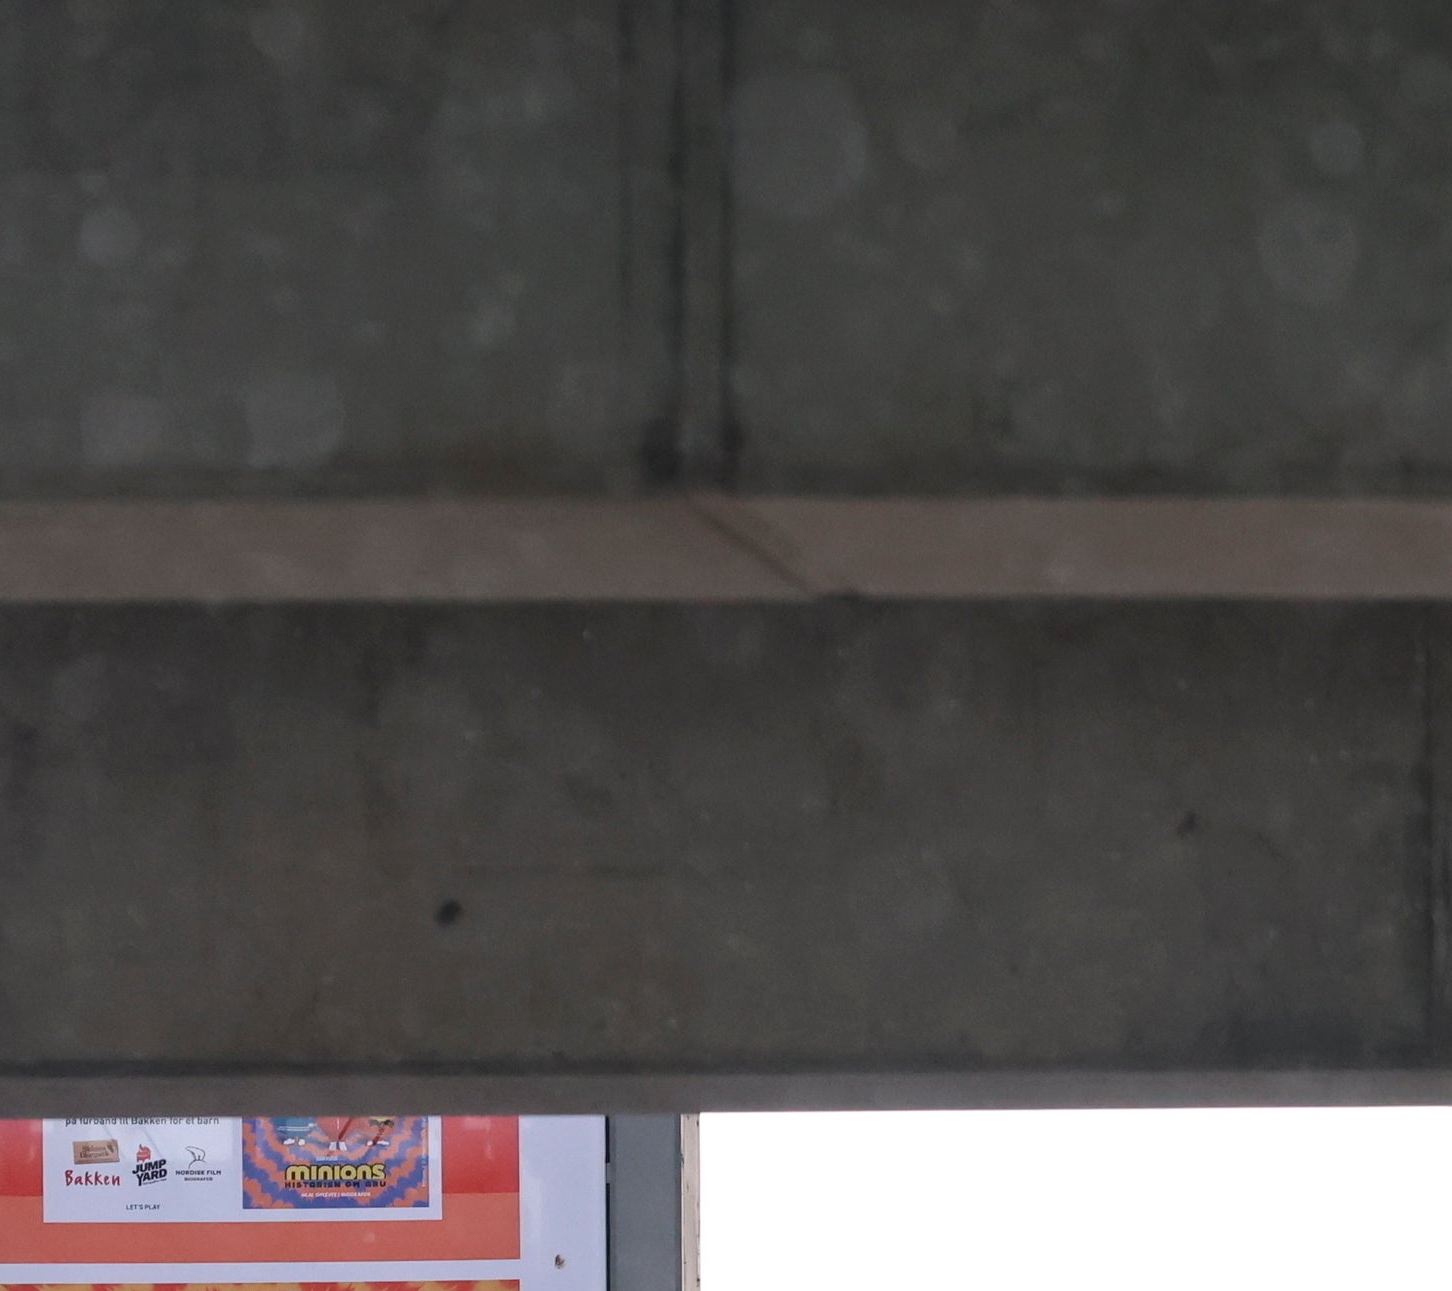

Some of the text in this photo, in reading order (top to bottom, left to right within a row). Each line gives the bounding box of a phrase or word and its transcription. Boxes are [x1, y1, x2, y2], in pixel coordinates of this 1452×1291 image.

[132, 1159, 167, 1175] JUMP
[65, 1170, 121, 1186] Bakken
[136, 1168, 167, 1187] YARD
